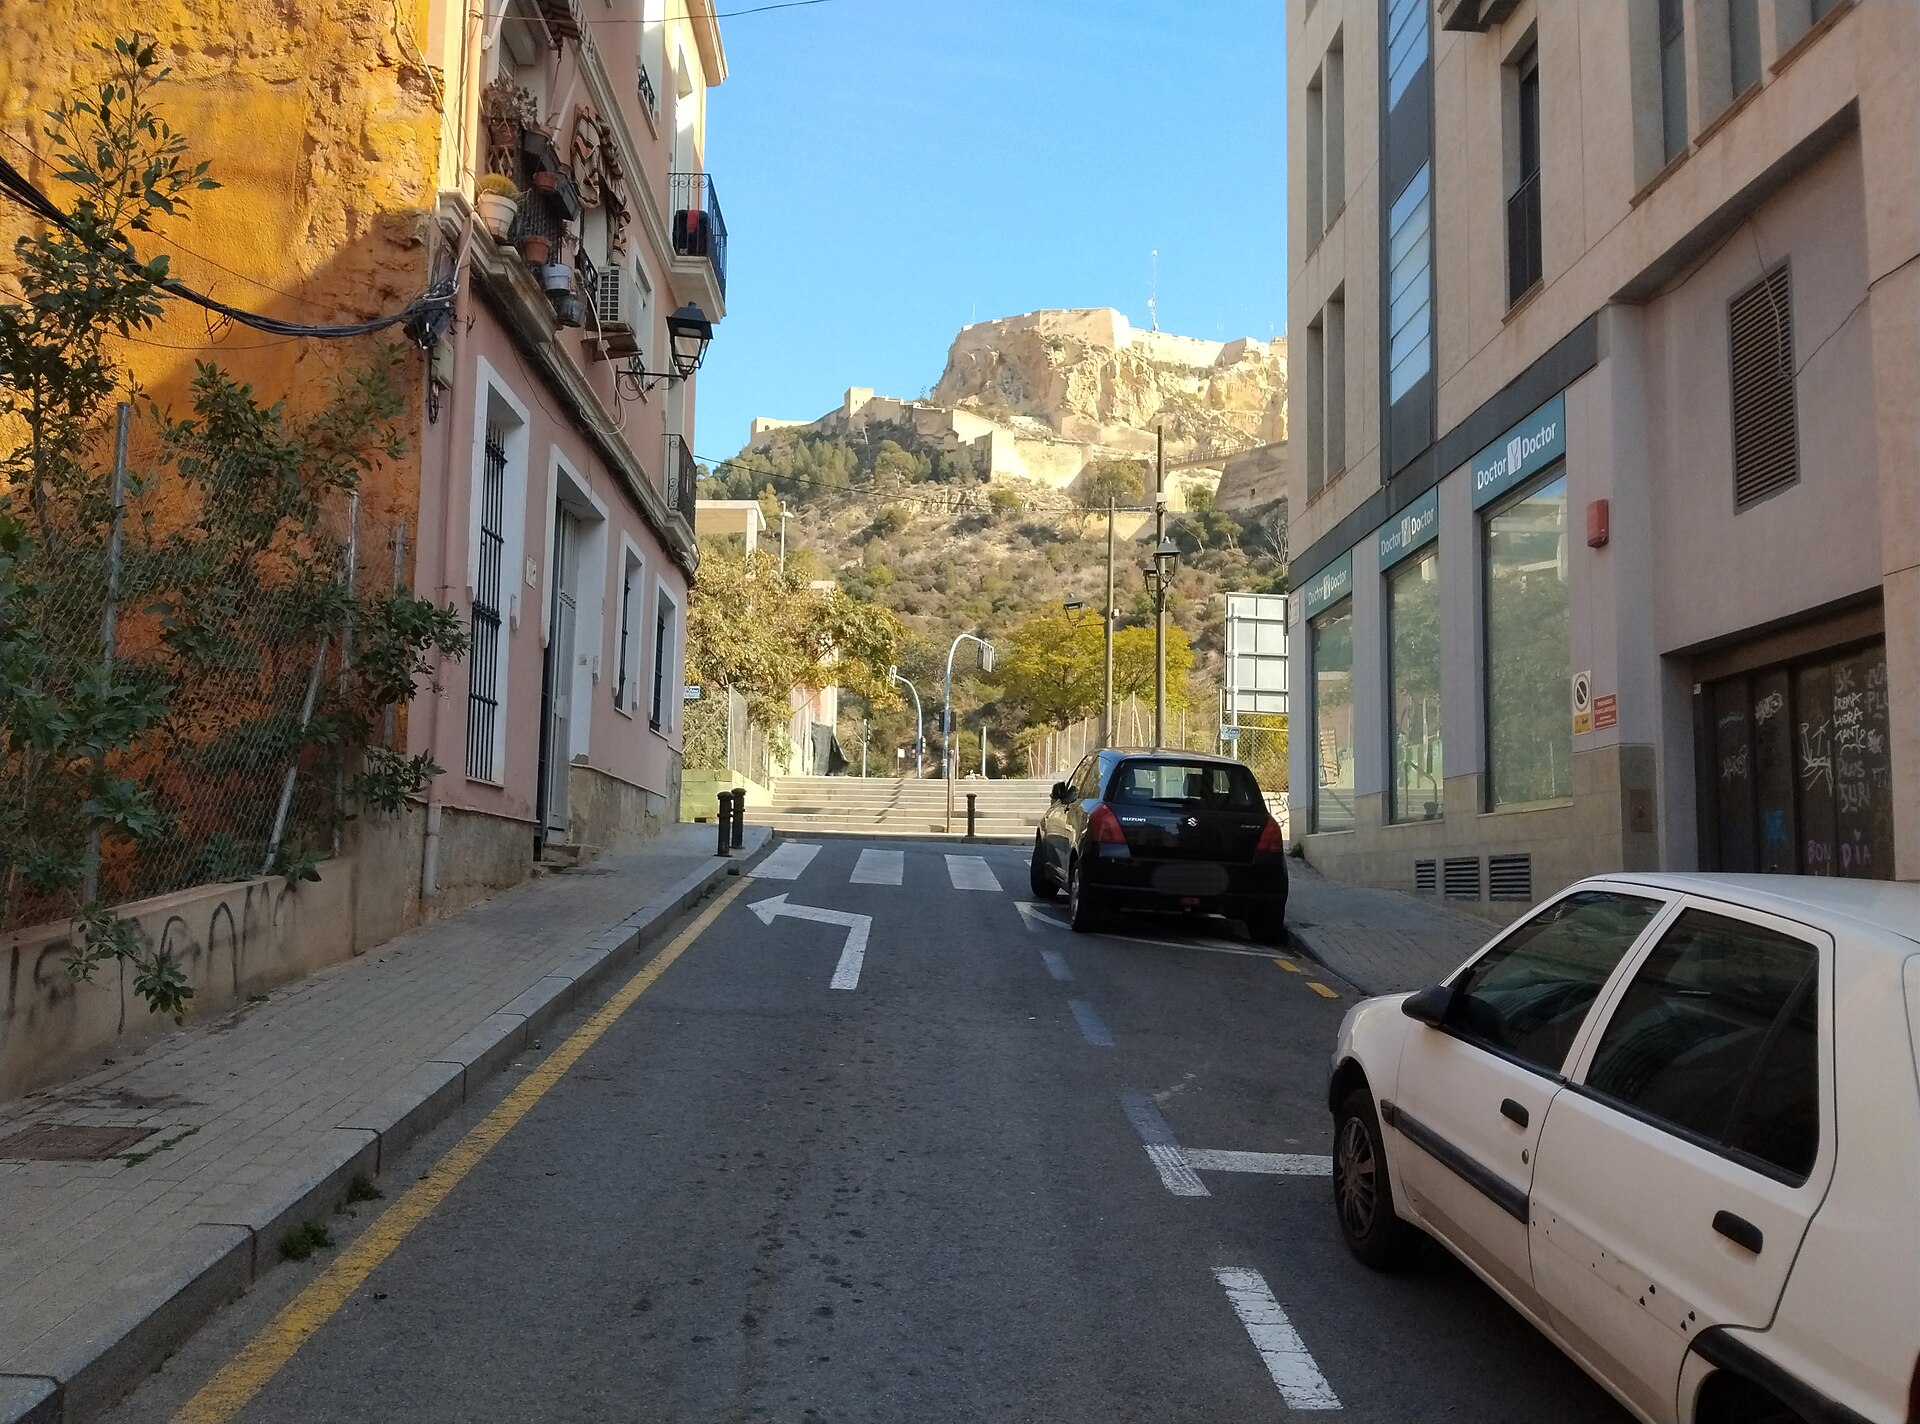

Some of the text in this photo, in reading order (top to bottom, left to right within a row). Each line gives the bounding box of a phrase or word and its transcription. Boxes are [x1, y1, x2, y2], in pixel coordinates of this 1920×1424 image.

[1477, 422, 1557, 490] Doctor Doctor
[1380, 508, 1434, 556] Doctor Doctor
[1308, 569, 1347, 605] Doctor Doctor
[1807, 839, 1832, 864] BON
